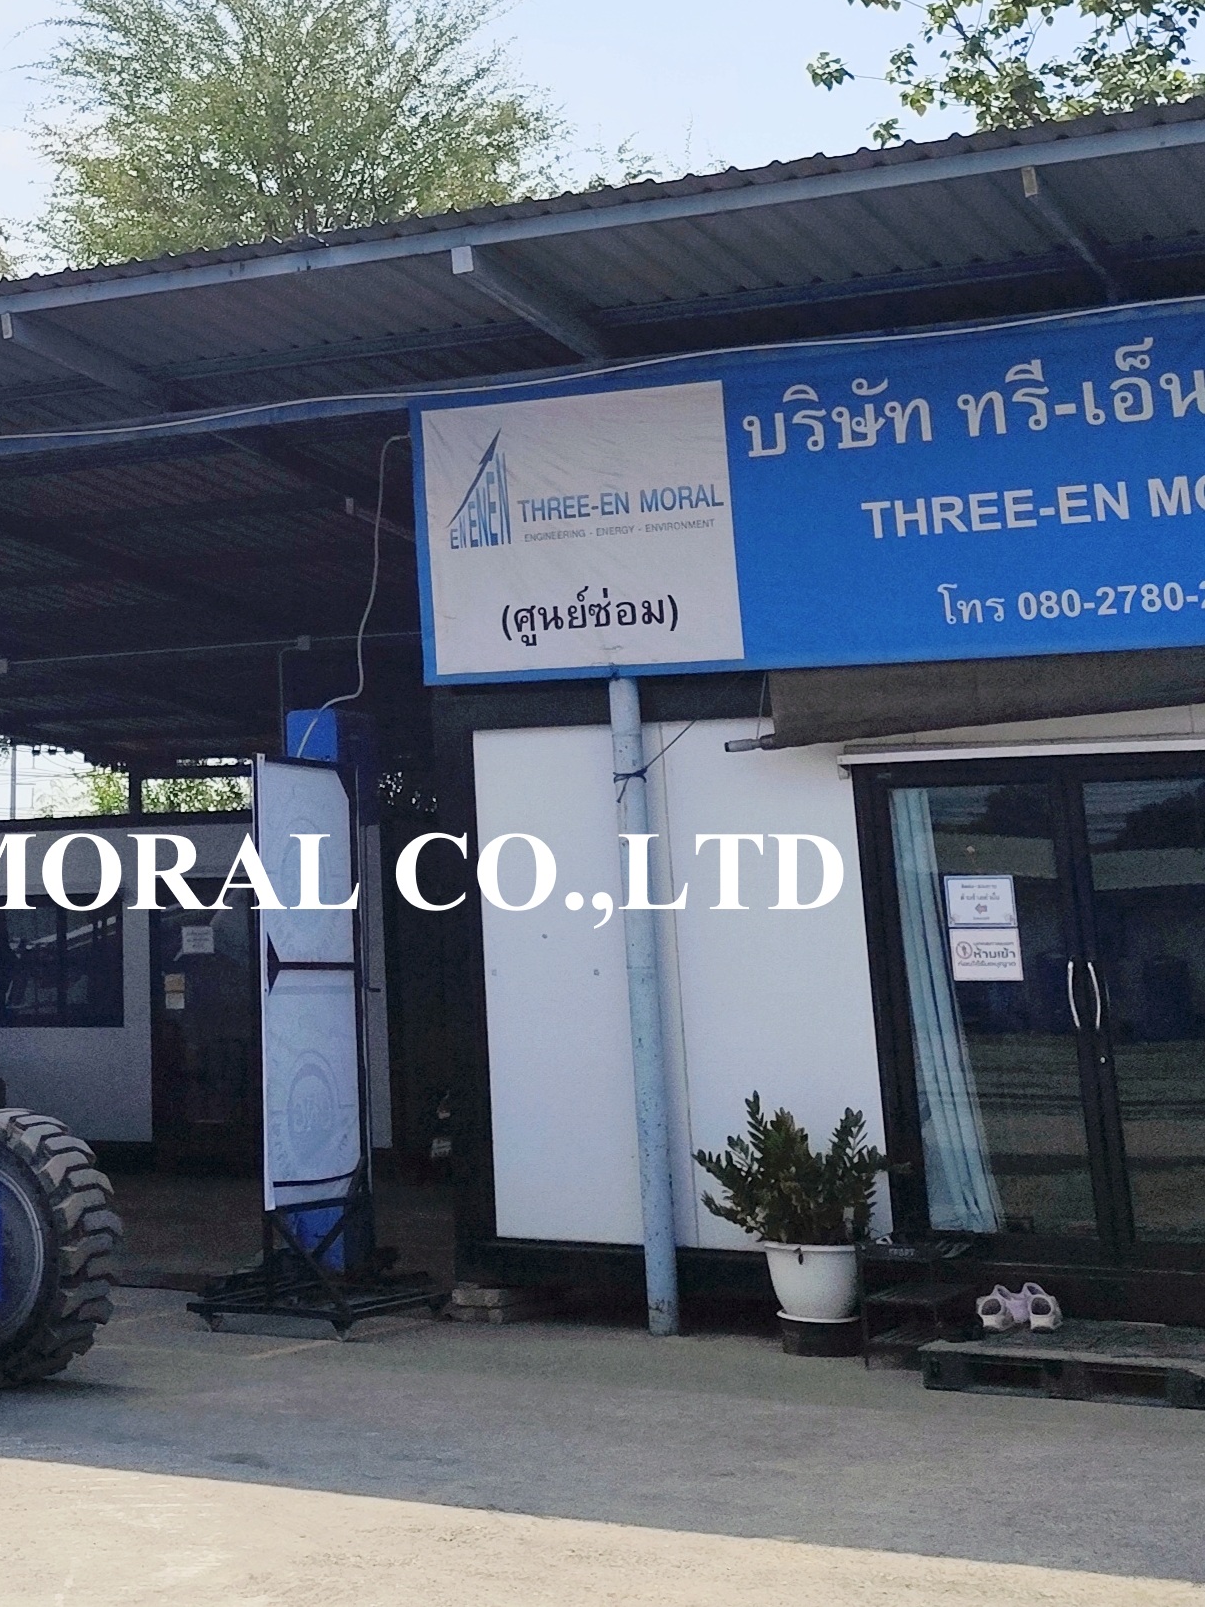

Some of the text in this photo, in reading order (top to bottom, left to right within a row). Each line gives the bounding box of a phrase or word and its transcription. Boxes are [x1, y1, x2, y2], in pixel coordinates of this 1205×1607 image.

[742, 377, 933, 458] บริษัท
[517, 484, 724, 523] THREE-EN MORAL
[861, 474, 1205, 539] THREE-EN M
[524, 528, 586, 543] ENGINEERING
[596, 525, 635, 537] ENERGY
[645, 518, 715, 534] ENVIRONMENT
[501, 585, 679, 647] (ศูนย์ซ่อม)
[937, 583, 1006, 625] โทร
